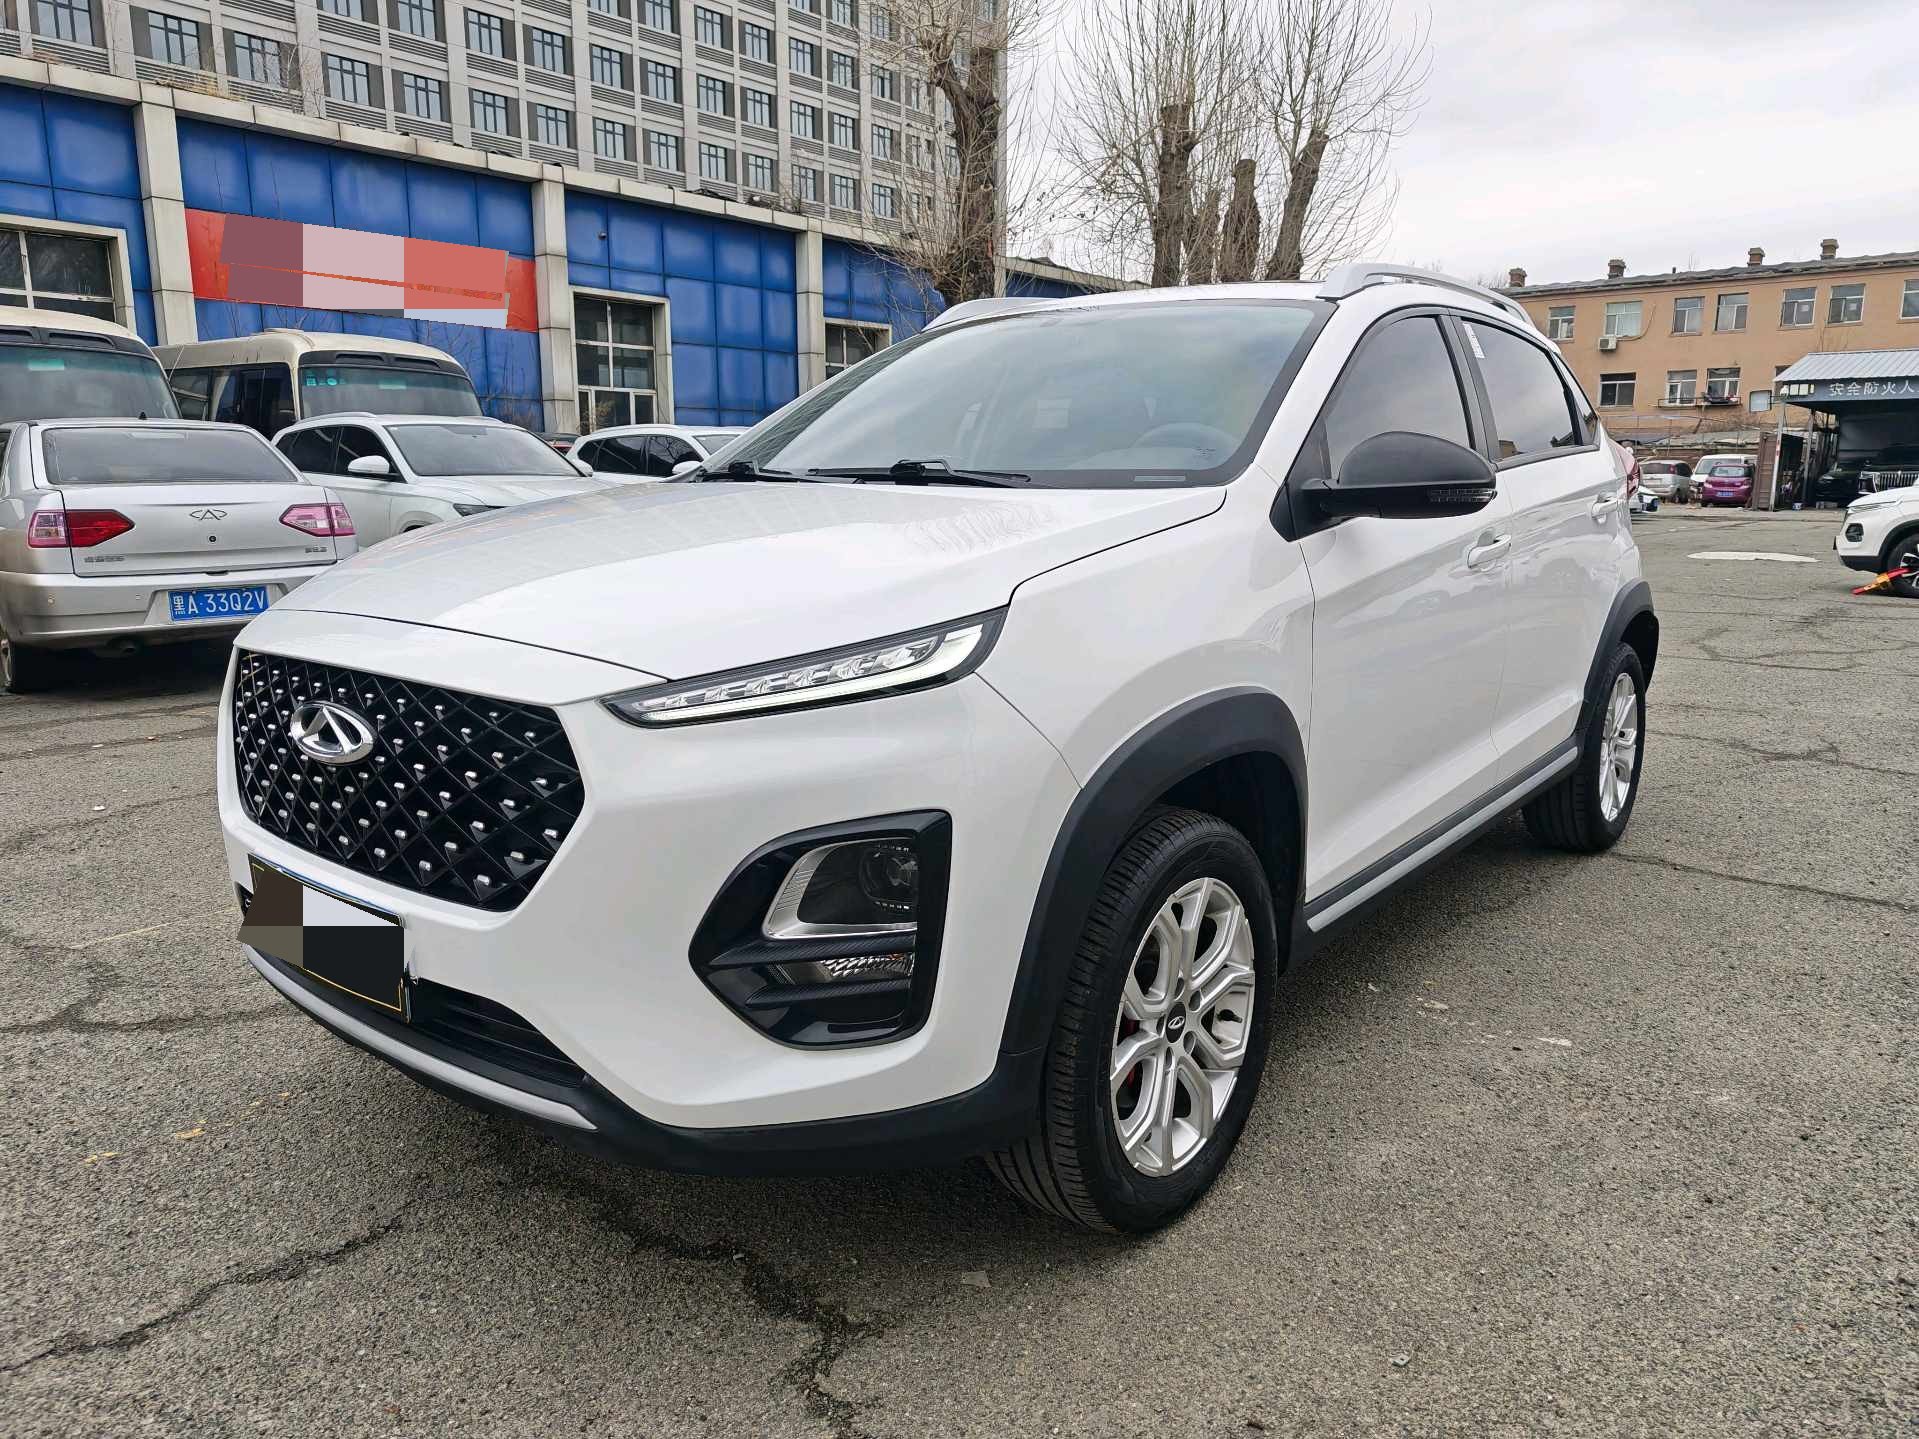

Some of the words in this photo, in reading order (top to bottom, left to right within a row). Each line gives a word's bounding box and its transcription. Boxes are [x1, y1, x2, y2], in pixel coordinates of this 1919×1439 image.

[1829, 380, 1919, 396] 安全防火人
